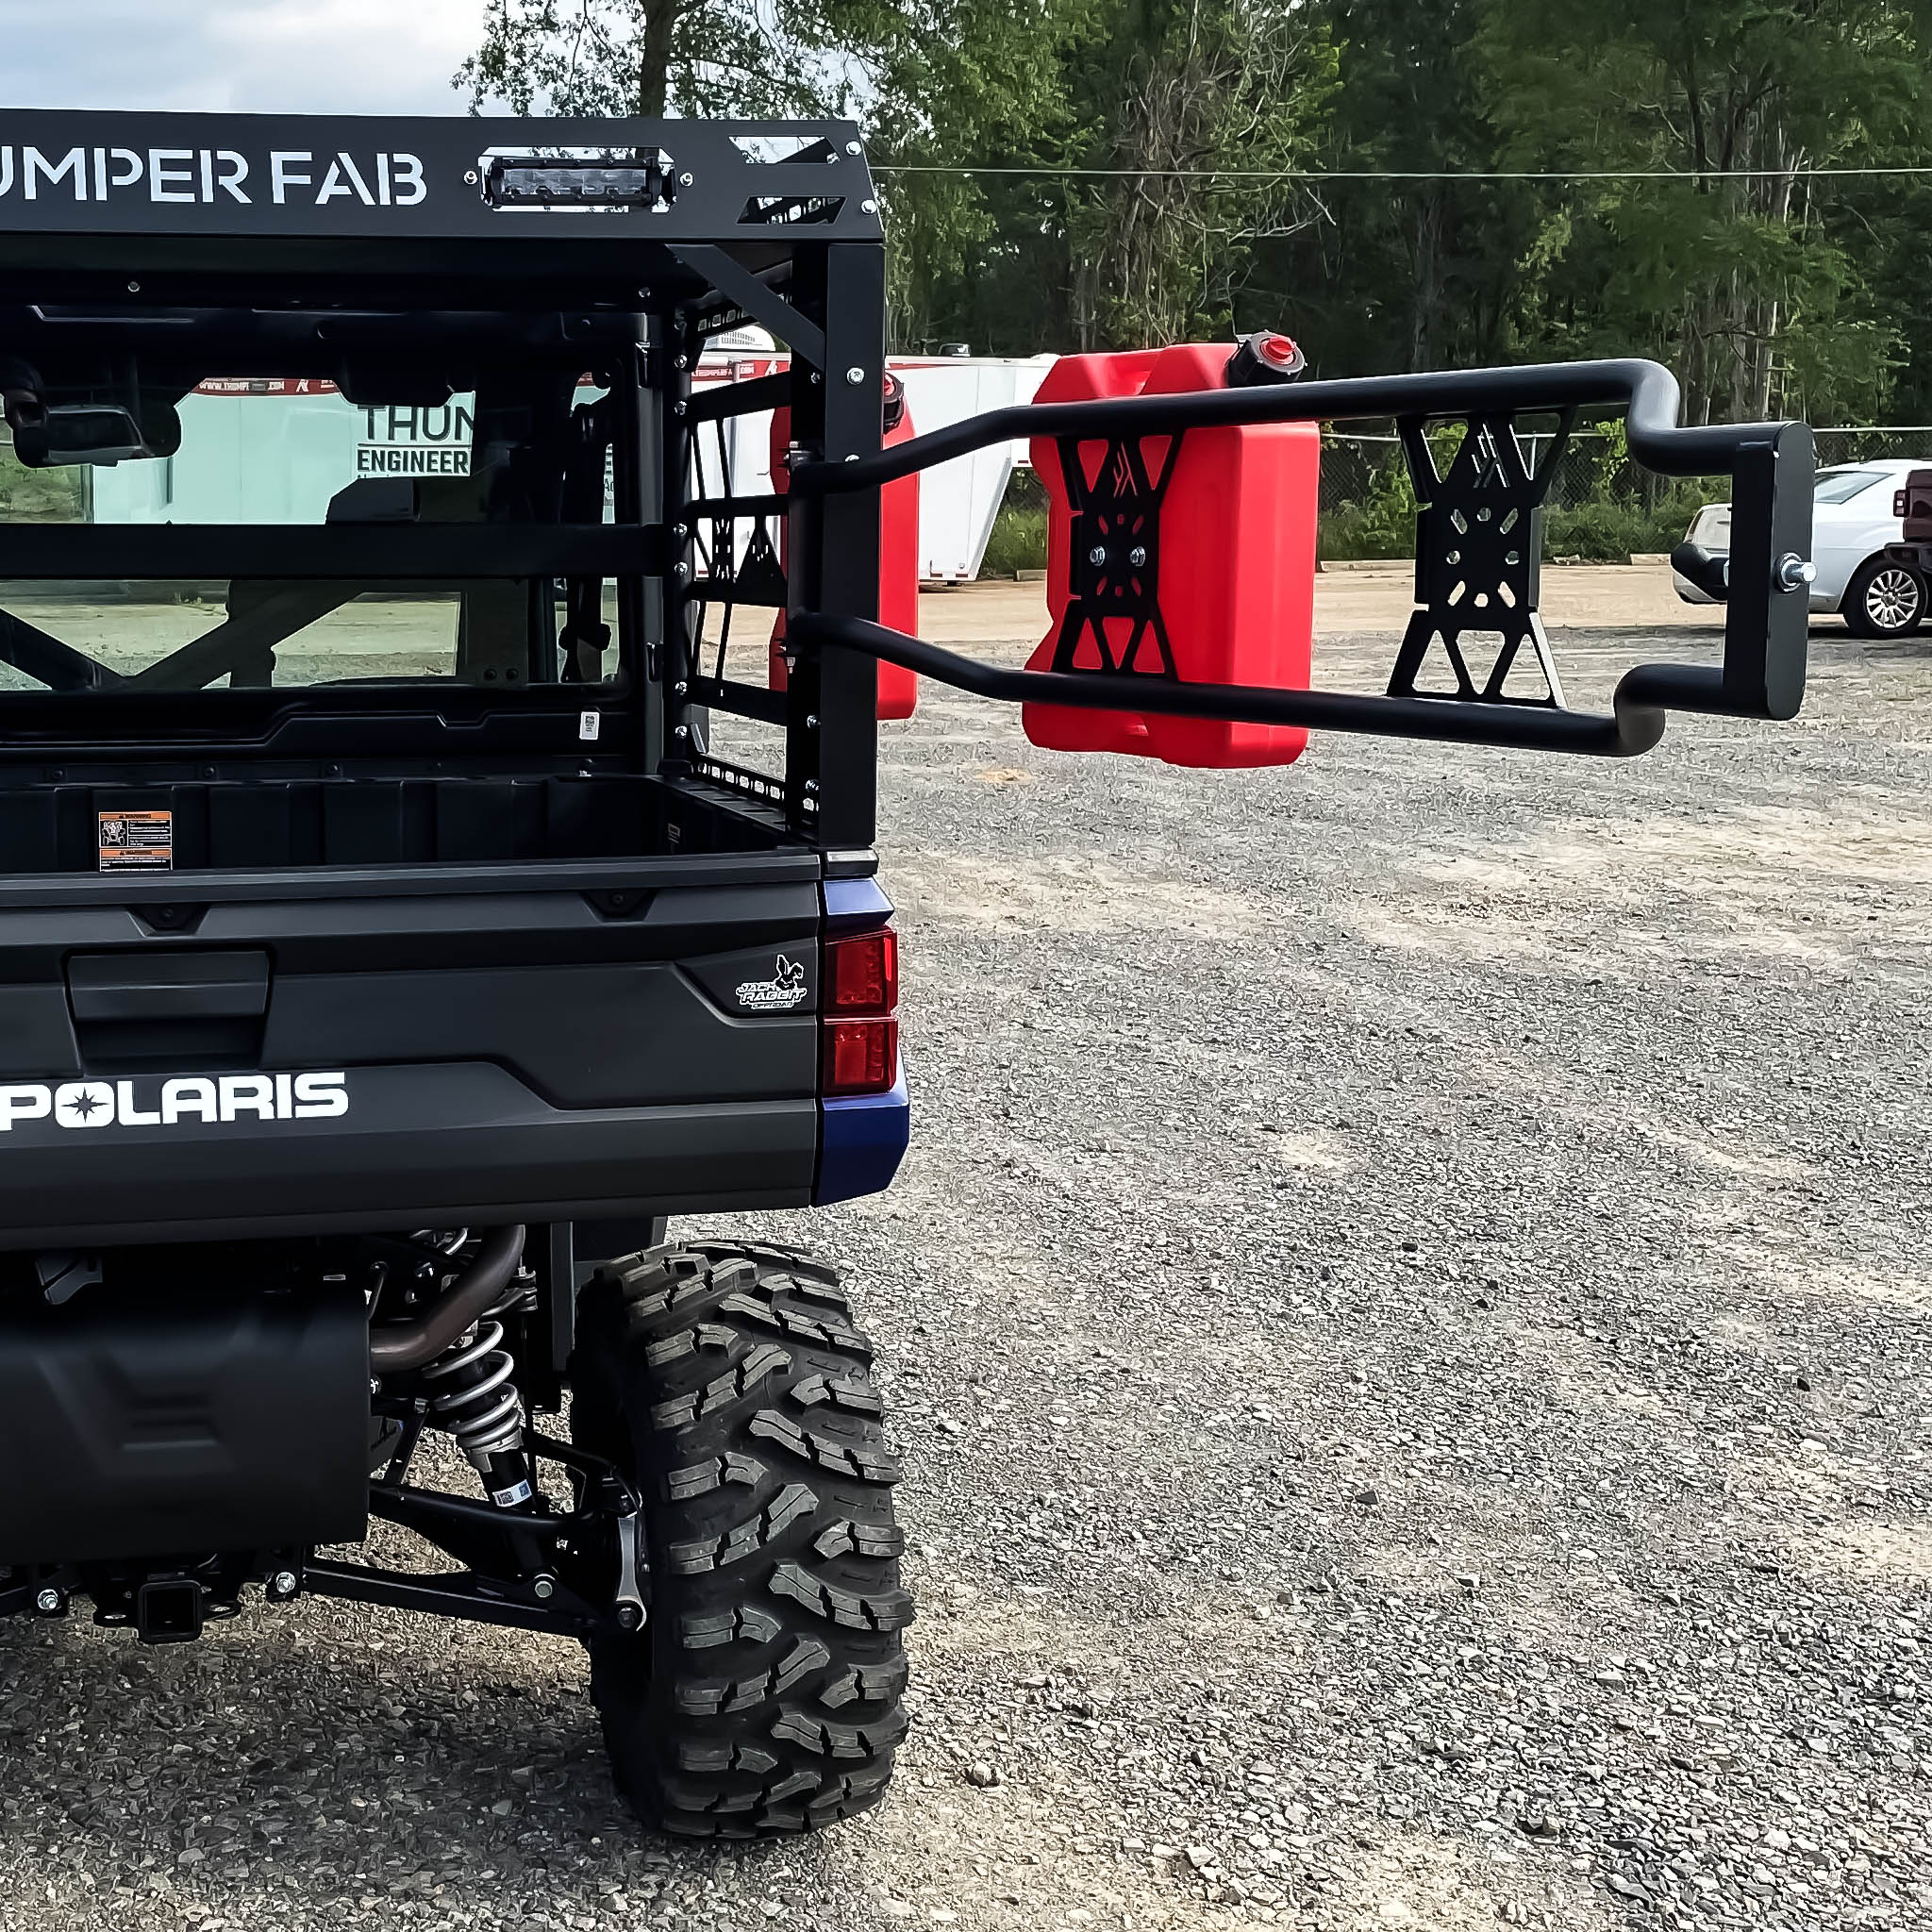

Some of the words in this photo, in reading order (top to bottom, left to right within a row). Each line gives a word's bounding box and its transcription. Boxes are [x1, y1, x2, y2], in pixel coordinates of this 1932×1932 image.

[270, 151, 428, 206] FAB
[358, 449, 470, 474] ENGINEER
[741, 988, 804, 1002] RABBIT
[0, 1072, 349, 1131] POLARIS
